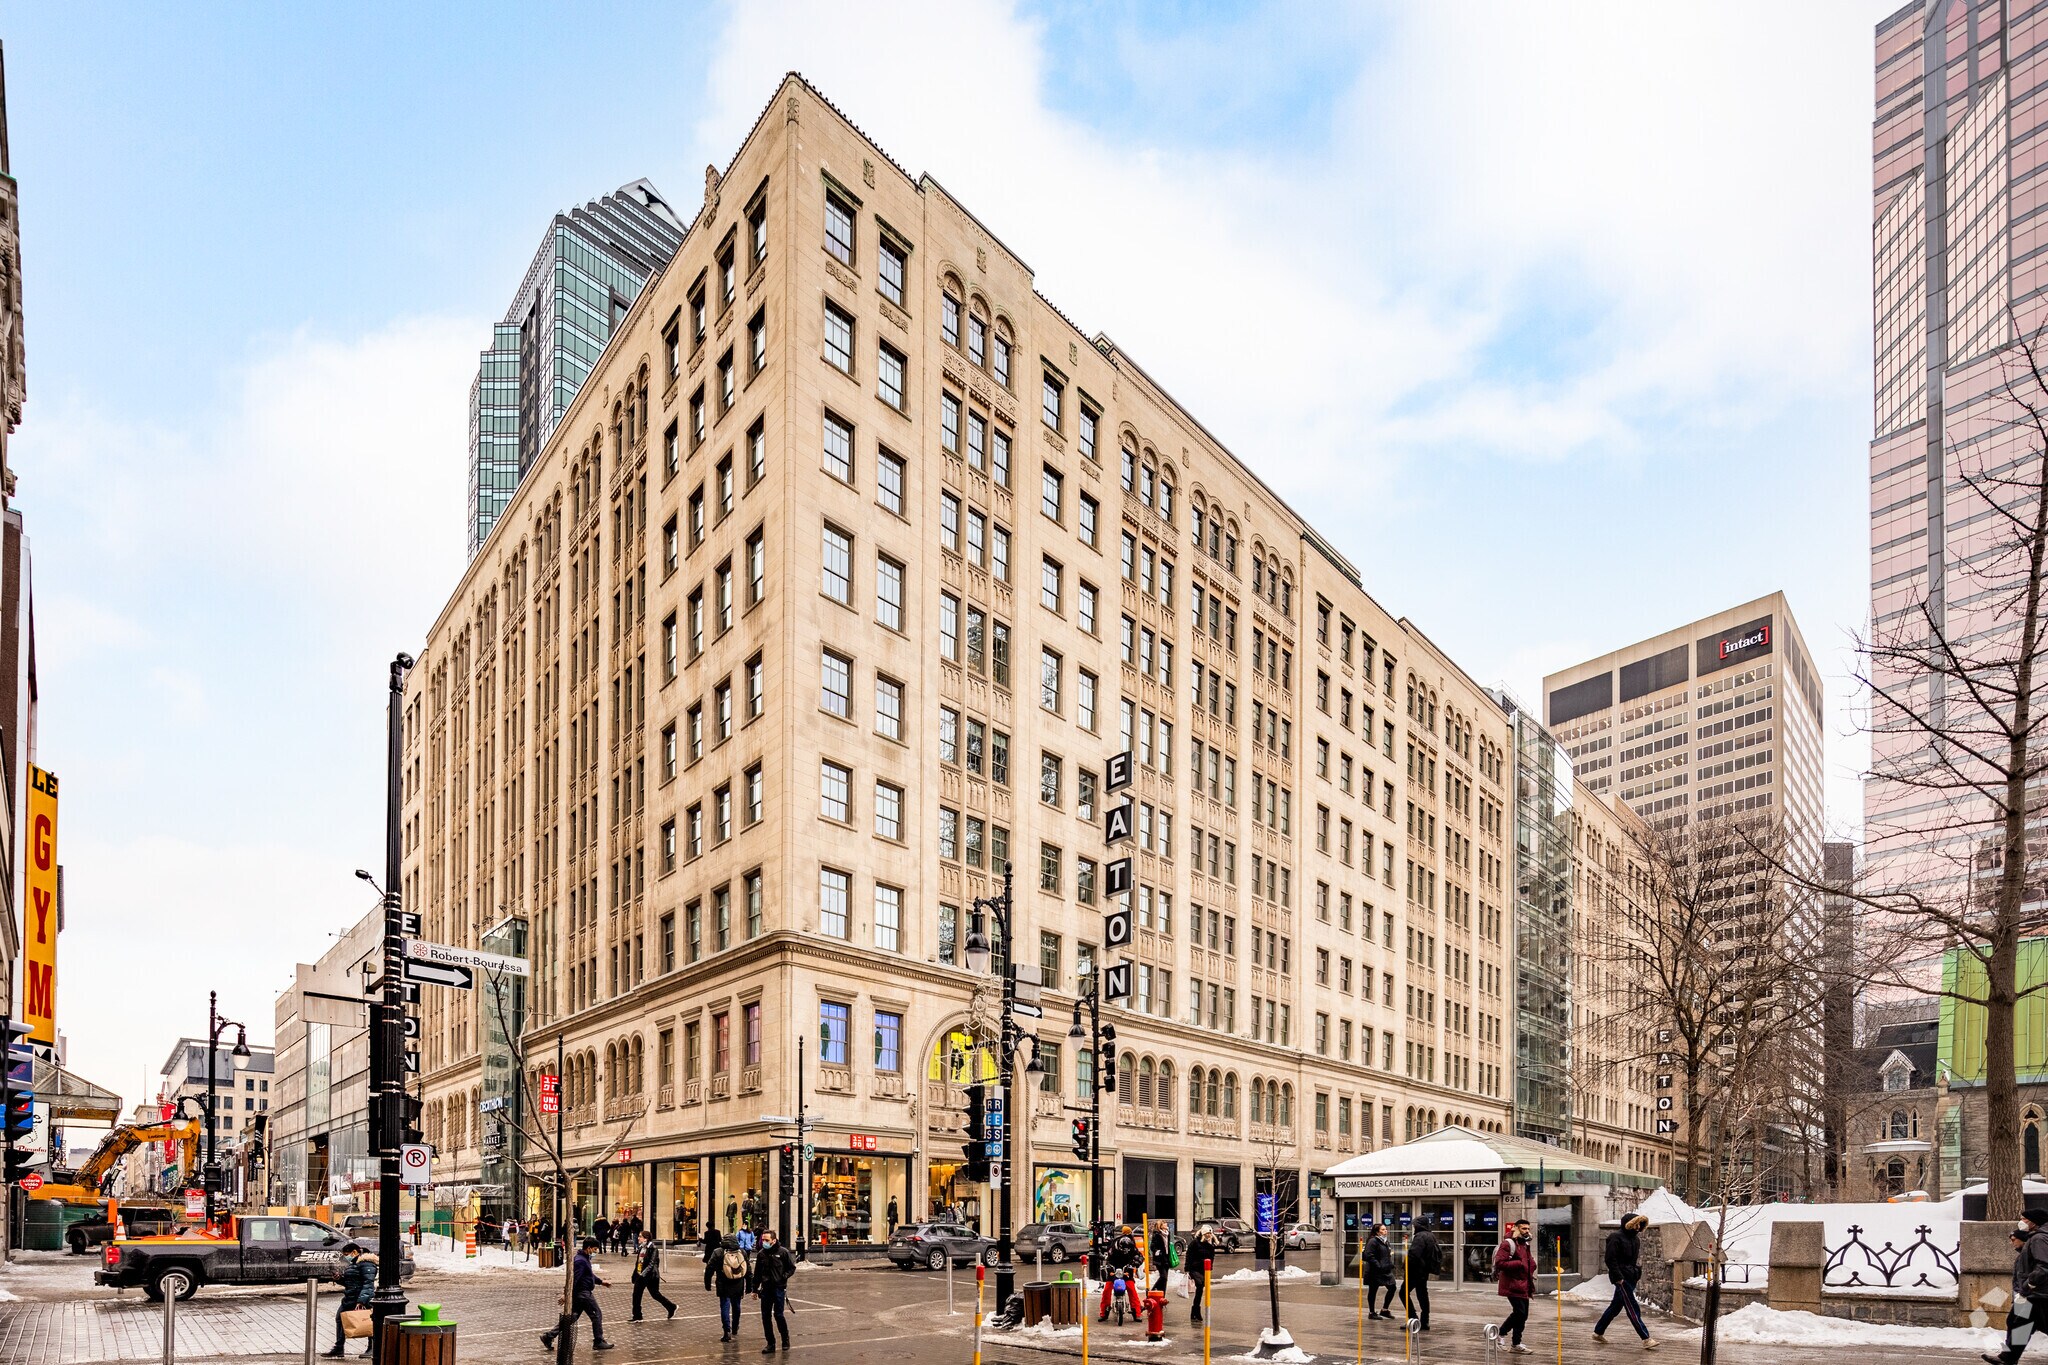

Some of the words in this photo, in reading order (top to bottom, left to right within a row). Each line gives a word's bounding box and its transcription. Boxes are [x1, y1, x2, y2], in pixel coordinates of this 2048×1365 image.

[1725, 632, 1764, 654] intact
[32, 767, 58, 799] LE
[1108, 754, 1127, 997] EATON
[29, 813, 53, 1019] GYM
[430, 949, 523, 973] Robert-Bourassa
[1338, 1180, 1383, 1188] PROMENADES
[1384, 1178, 1429, 1187] CATHÉDRALE
[1433, 1180, 1462, 1189] LINEN
[1465, 1179, 1497, 1188] CHEST
